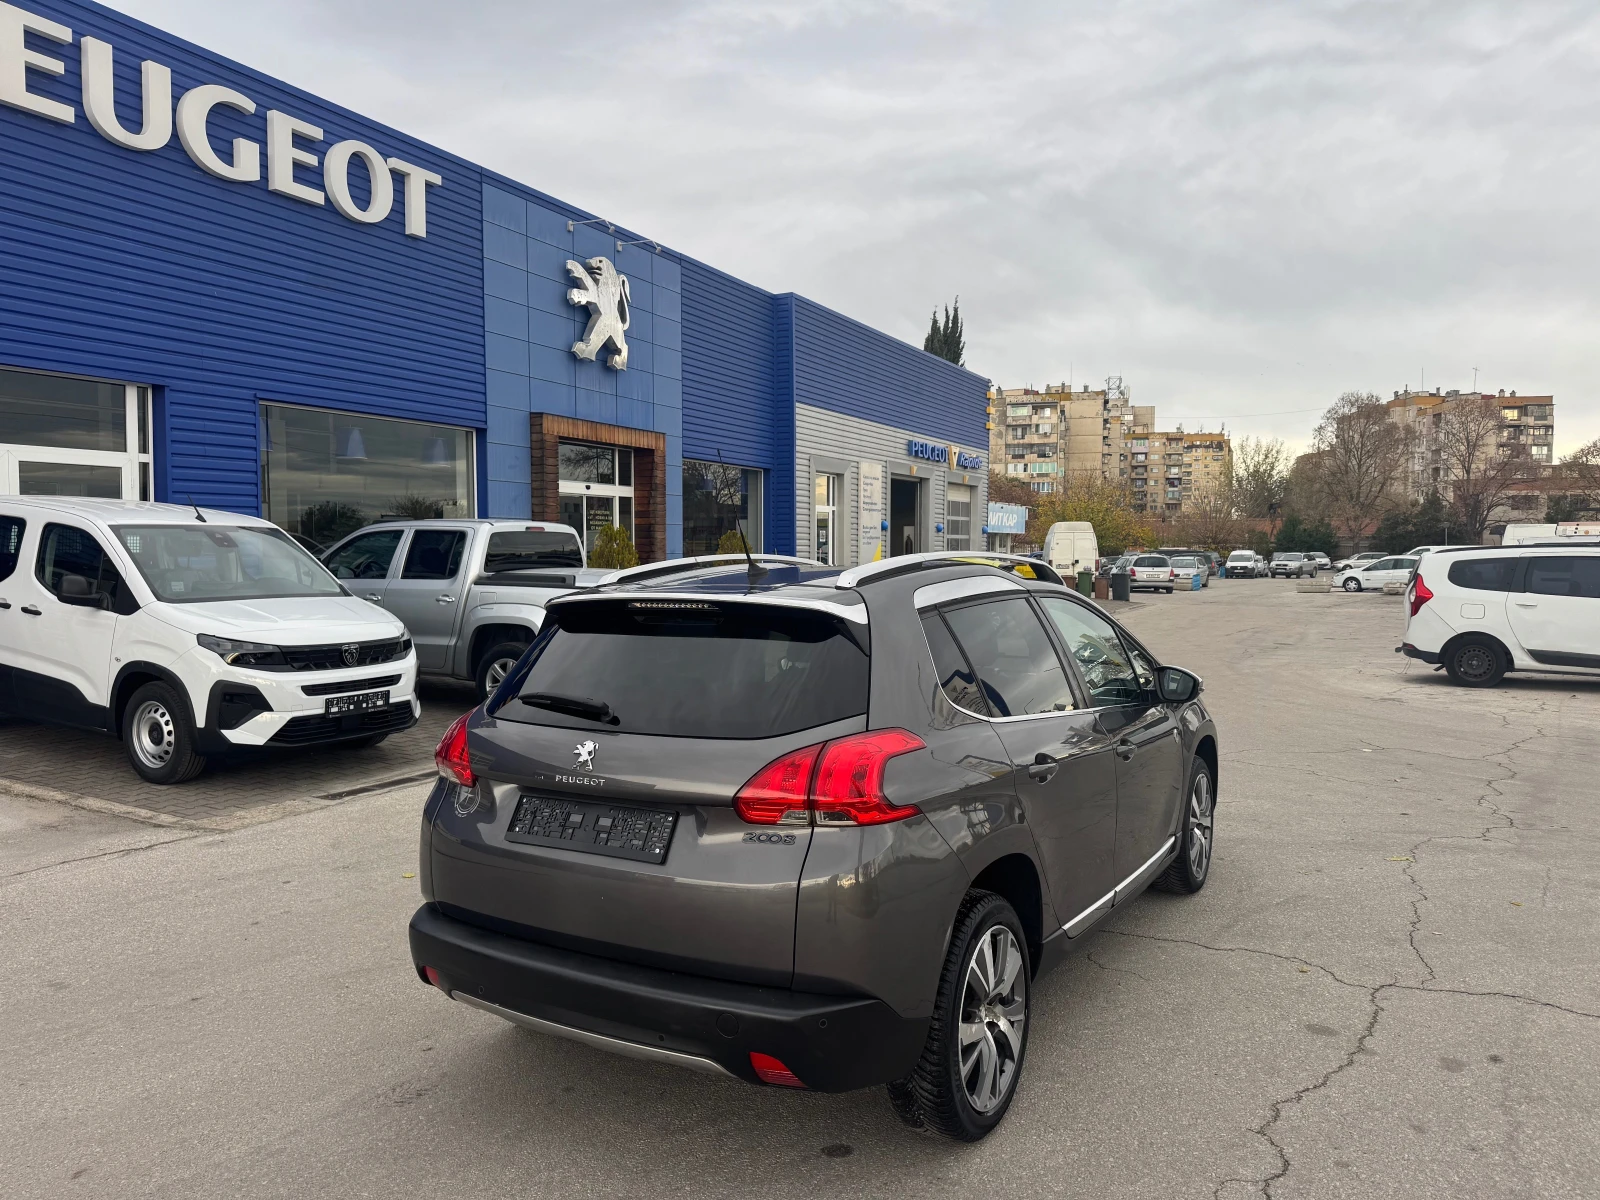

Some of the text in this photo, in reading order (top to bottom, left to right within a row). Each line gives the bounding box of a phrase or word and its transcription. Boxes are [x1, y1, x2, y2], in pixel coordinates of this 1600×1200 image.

[0, 1, 442, 238] EUGEOT
[909, 439, 949, 463] PEUGEOT
[555, 774, 606, 787] PEUGEOT
[742, 831, 797, 846] 2008
